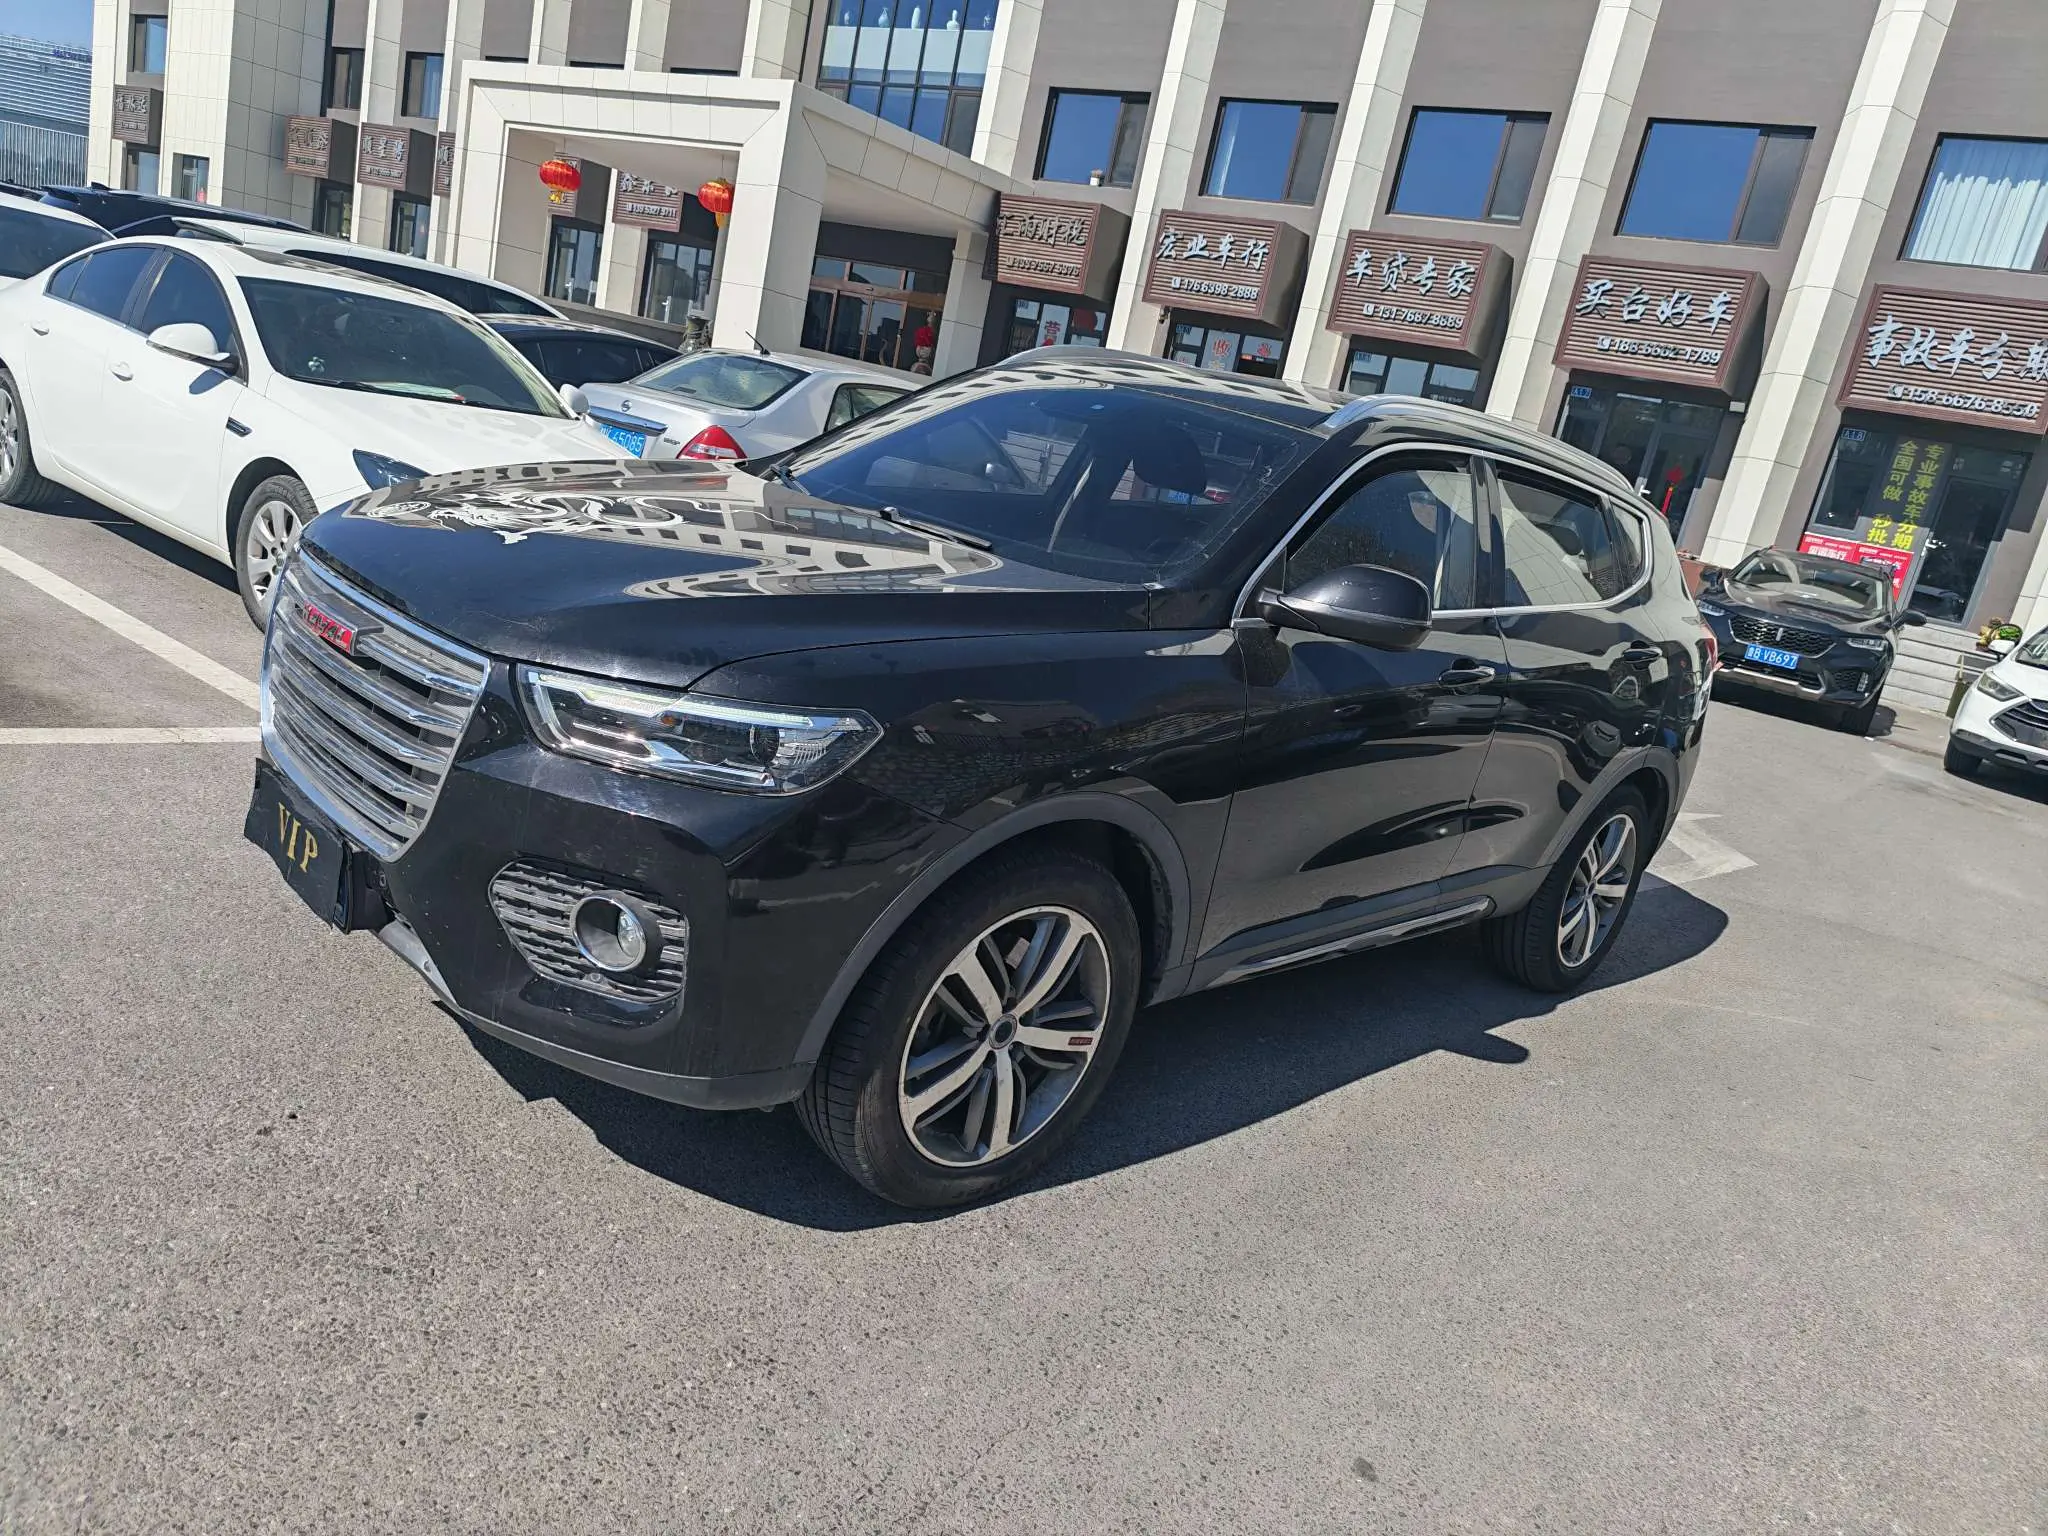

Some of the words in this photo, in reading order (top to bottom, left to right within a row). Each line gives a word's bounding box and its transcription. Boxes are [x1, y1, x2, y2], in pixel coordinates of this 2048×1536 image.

[1156, 227, 1269, 270] 宏业车行
[1346, 250, 1476, 299] 车贷专家
[1576, 279, 1733, 336] 买台好车
[278, 802, 318, 873] VIP
